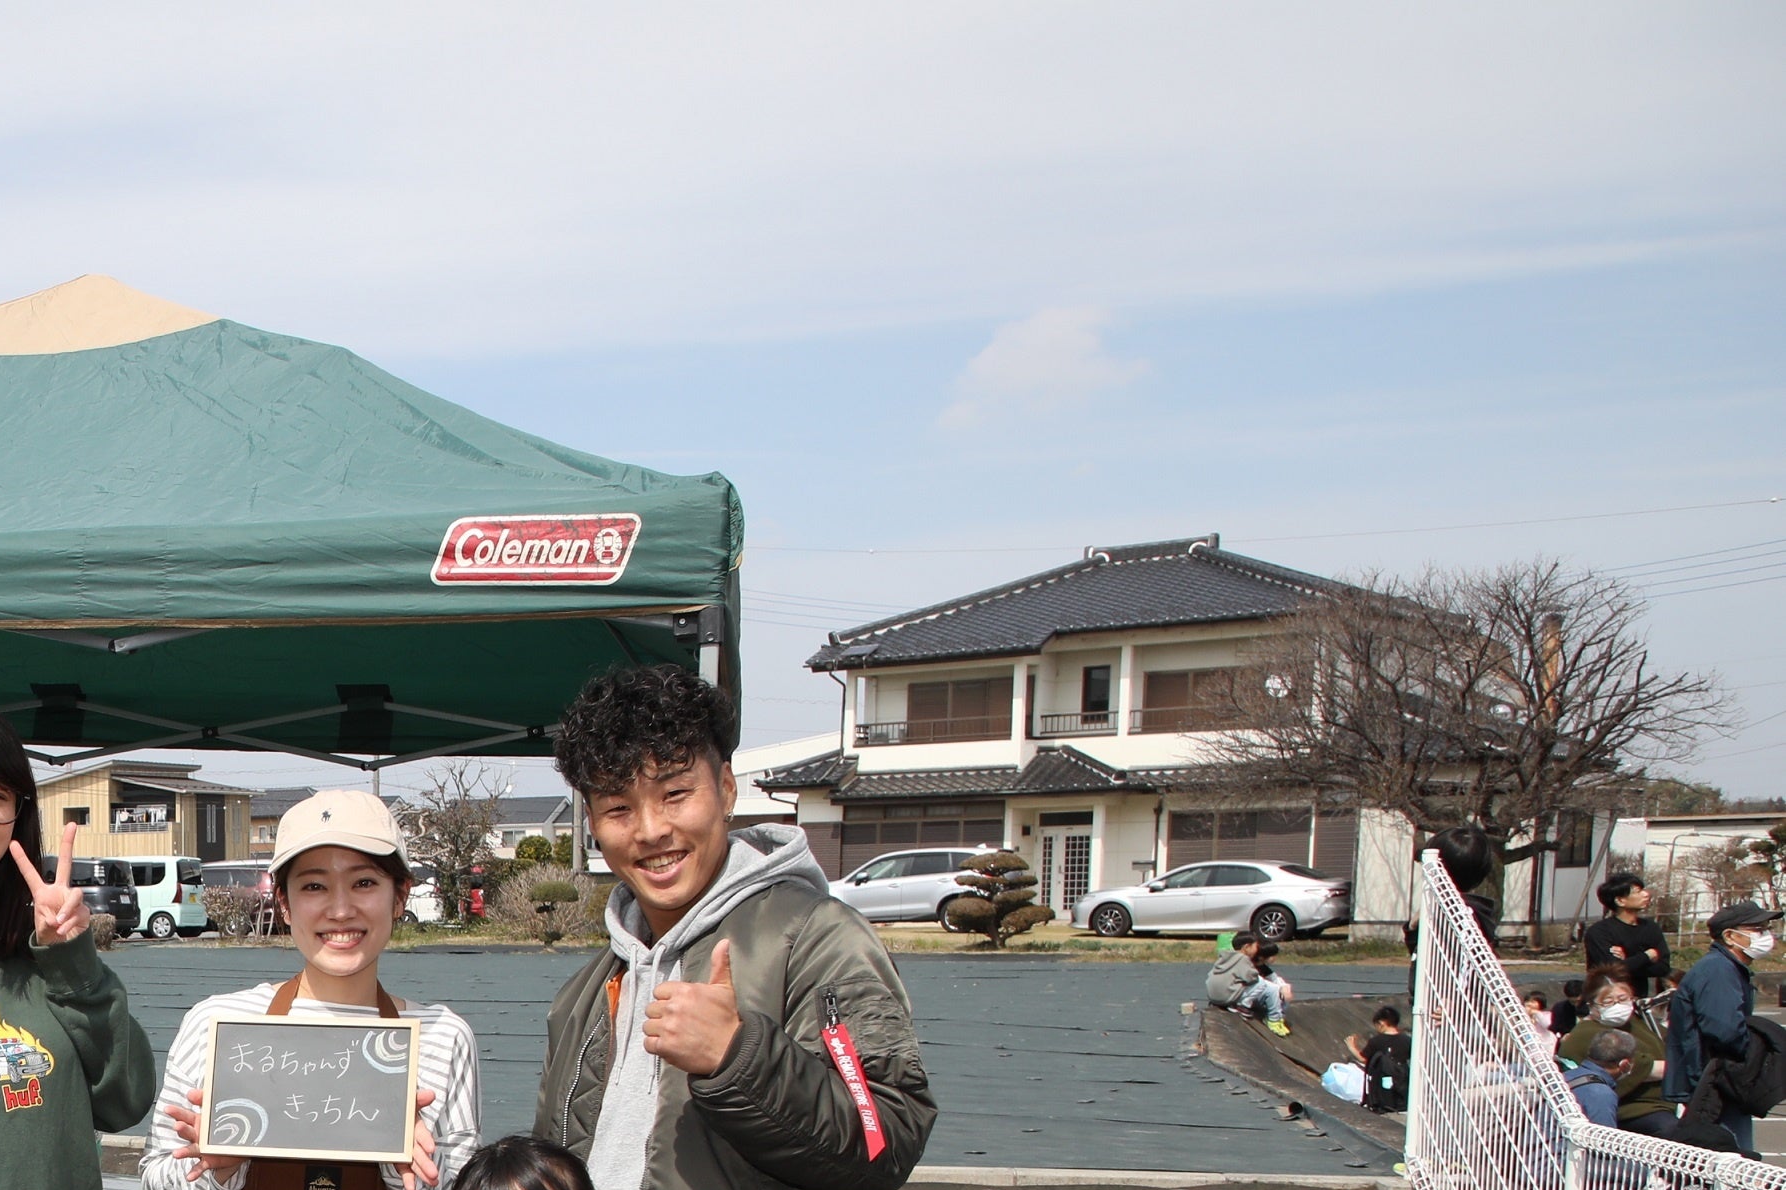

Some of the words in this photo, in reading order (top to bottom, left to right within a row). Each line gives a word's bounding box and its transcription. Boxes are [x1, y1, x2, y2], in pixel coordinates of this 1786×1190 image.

[454, 528, 591, 567] Coleman
[228, 1040, 360, 1079] まるちゃんず
[283, 1094, 381, 1125] きっちん
[838, 1054, 857, 1082] REMOVE
[850, 1081, 870, 1107] BEFORE
[860, 1109, 878, 1132] FLIGHT
